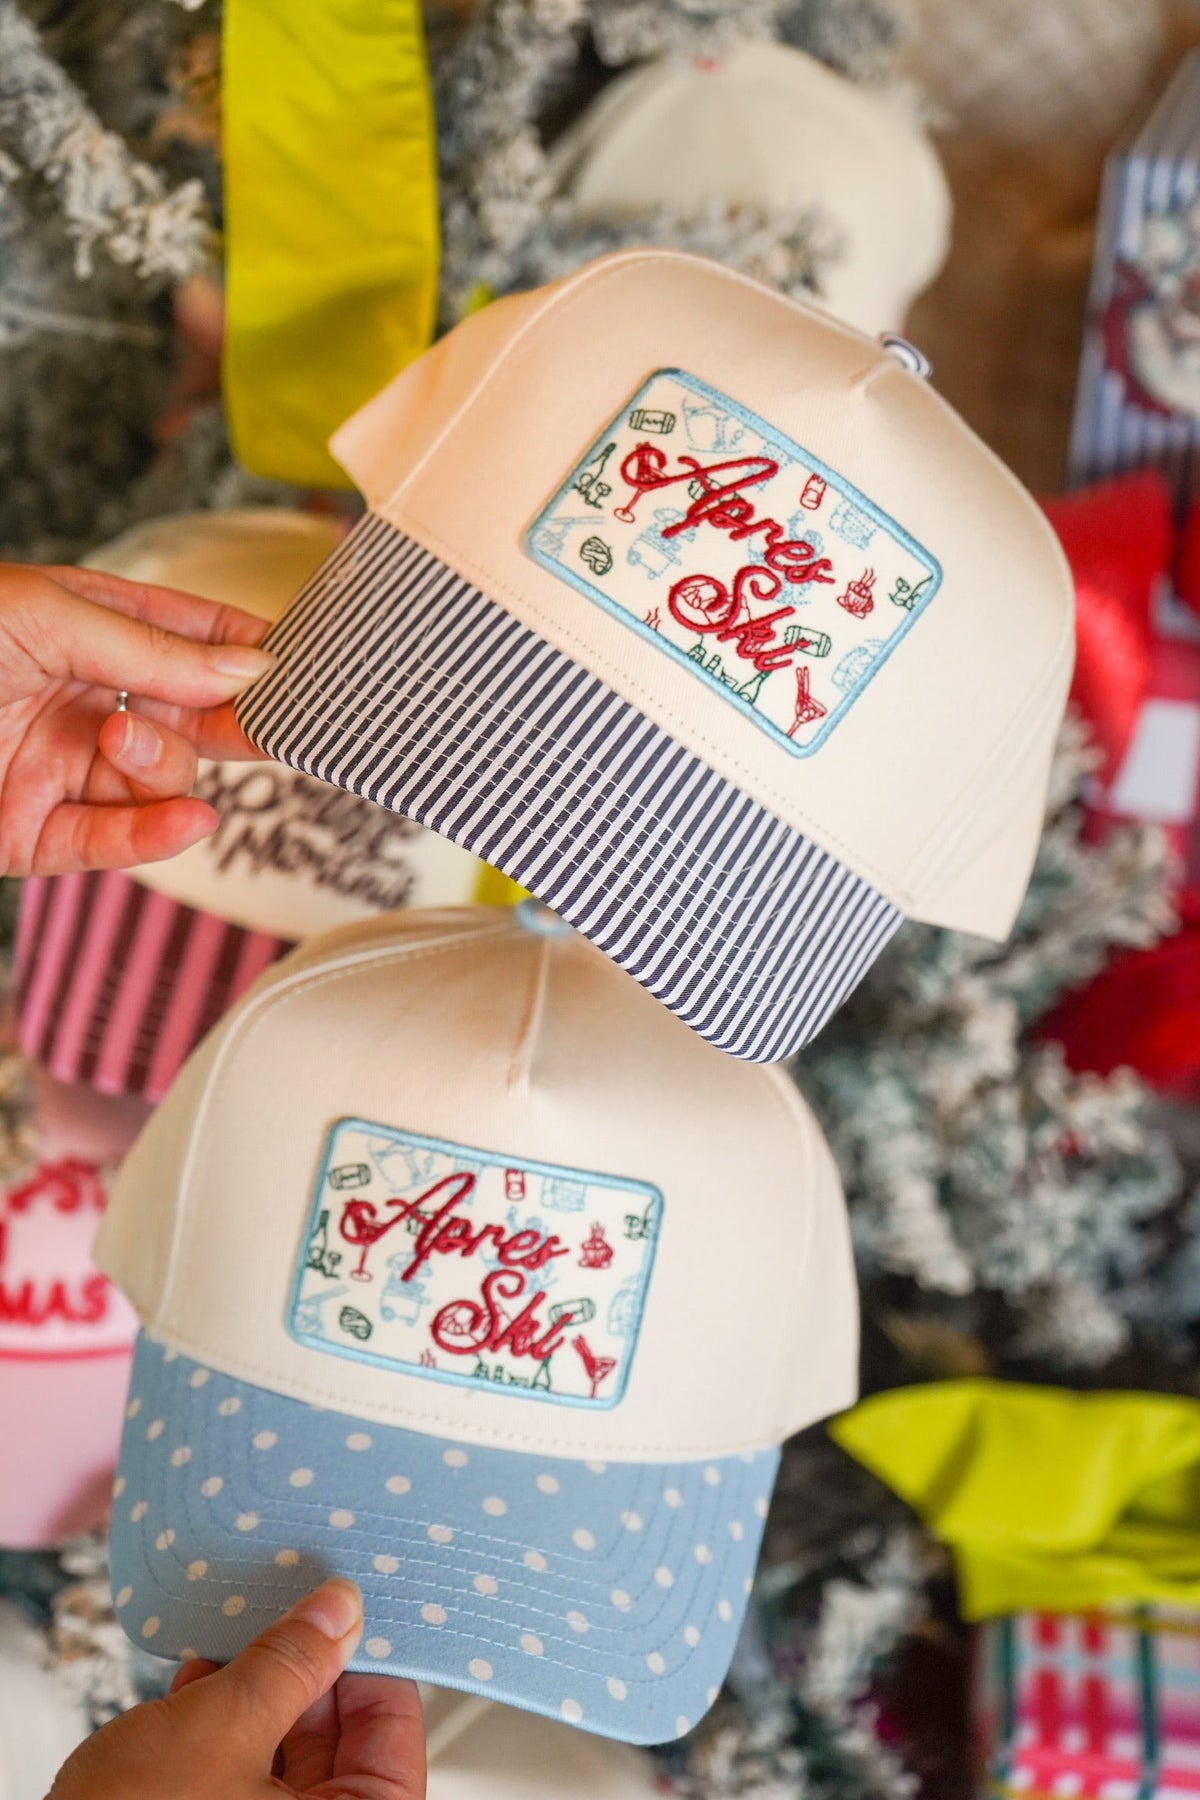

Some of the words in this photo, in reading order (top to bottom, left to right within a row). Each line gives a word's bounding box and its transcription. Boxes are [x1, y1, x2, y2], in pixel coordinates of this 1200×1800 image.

[620, 446, 836, 585] Apres
[667, 565, 810, 673] Ski
[339, 1172, 569, 1282] Apres
[430, 1269, 573, 1360] Ski
